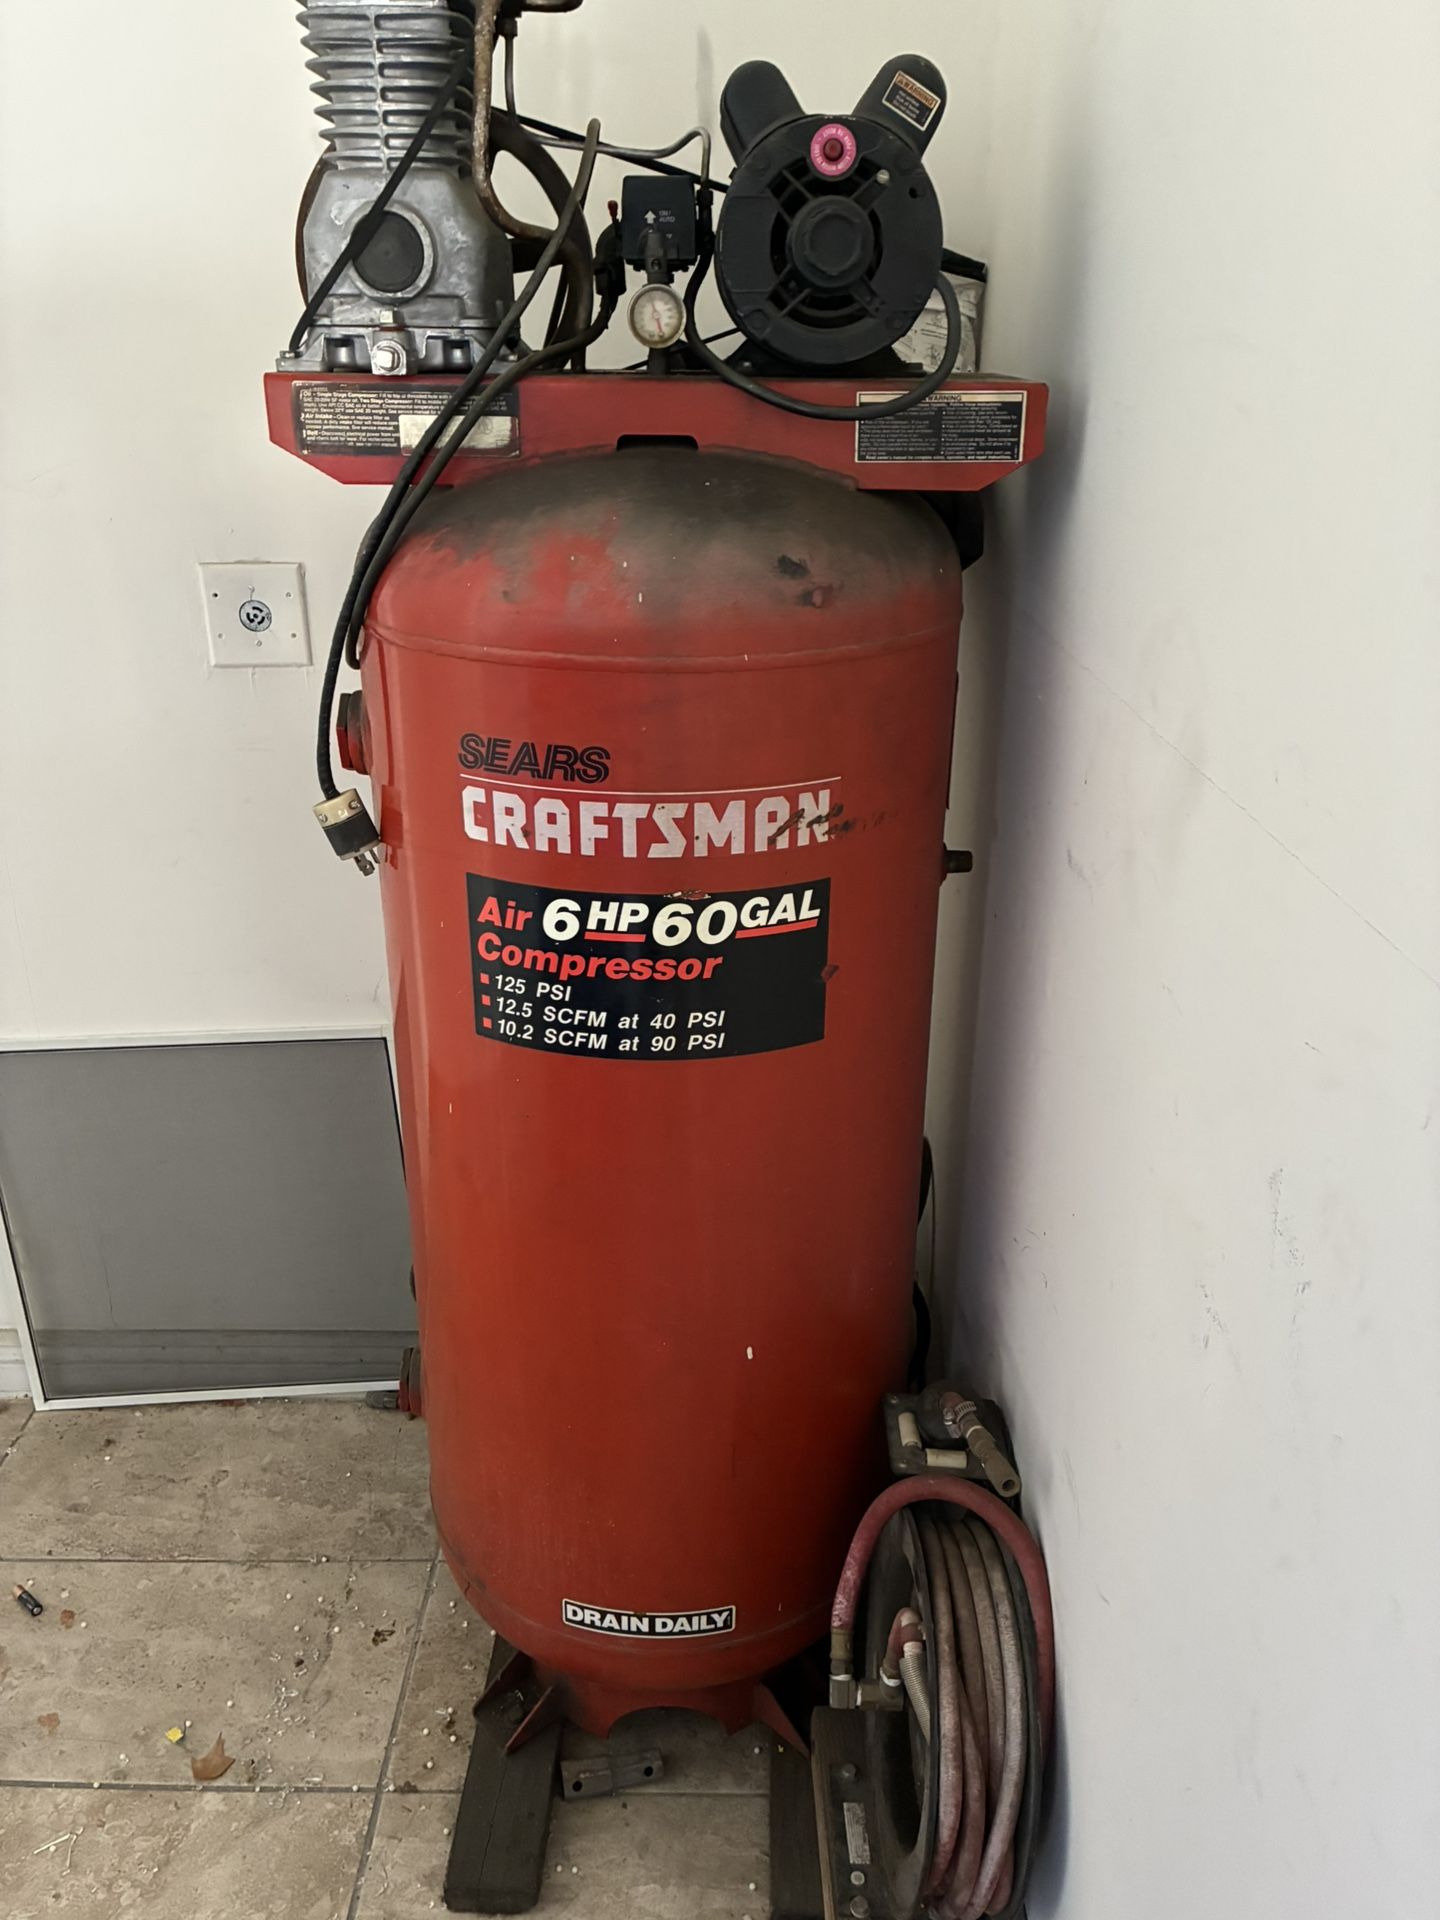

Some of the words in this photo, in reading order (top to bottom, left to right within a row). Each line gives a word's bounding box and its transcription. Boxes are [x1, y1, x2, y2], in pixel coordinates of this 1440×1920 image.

[458, 732, 611, 784] SEARS
[462, 786, 831, 859] CRAFTSMAN
[477, 896, 533, 931] Air
[652, 900, 738, 947] 60
[740, 889, 821, 928] GAL
[477, 932, 722, 982] Compressor
[495, 974, 526, 994] 125
[536, 982, 572, 1002] PSI
[496, 997, 532, 1018] 12.5
[543, 1006, 607, 1028] SCFM
[618, 1013, 640, 1030] at
[650, 1012, 676, 1030] 40
[688, 1010, 726, 1028] PSI
[497, 1018, 534, 1040] 10.2
[544, 1028, 608, 1050] SCFM
[618, 1034, 640, 1052] at
[650, 1034, 676, 1052] 90
[688, 1032, 726, 1050] PSI
[566, 1604, 650, 1633] DRAIN
[655, 1610, 730, 1633] DAILY
